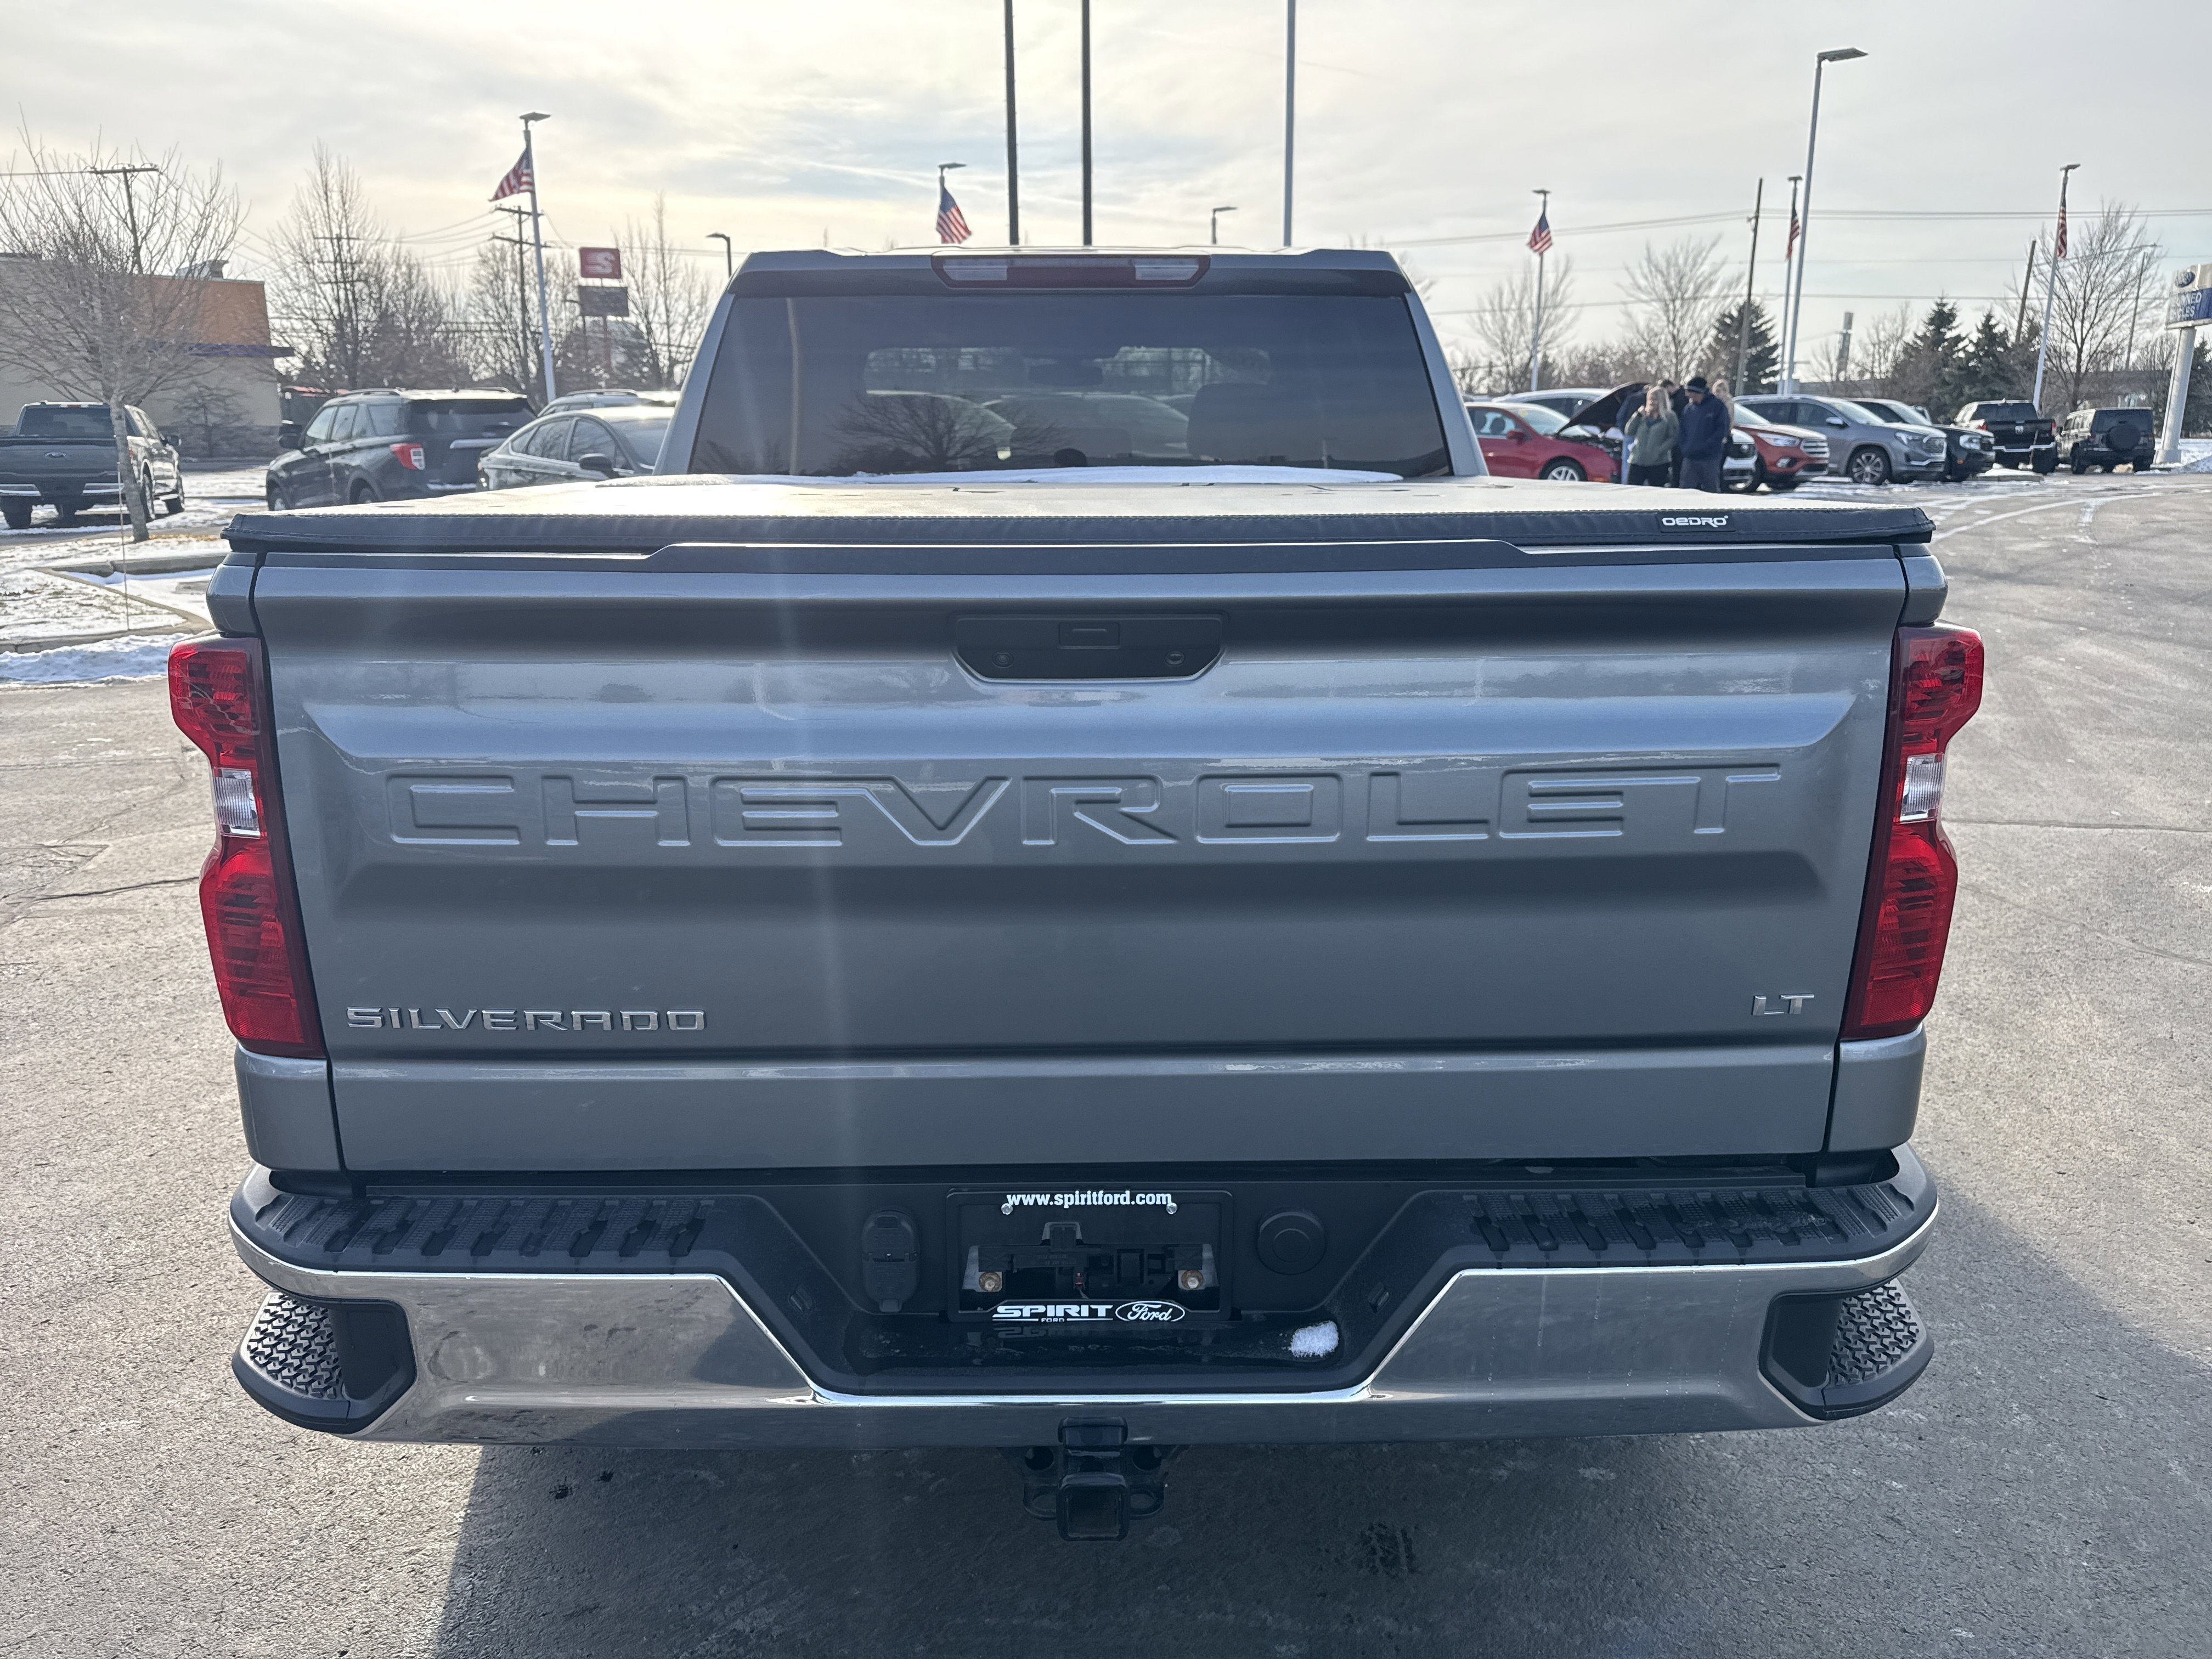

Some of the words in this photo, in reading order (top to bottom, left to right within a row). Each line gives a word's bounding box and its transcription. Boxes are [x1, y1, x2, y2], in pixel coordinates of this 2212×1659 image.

[1662, 517, 1727, 528] OEDRO
[386, 764, 1781, 848] CHEVROLET
[1751, 993, 1815, 1015] LT
[347, 1007, 708, 1031] SILVERADO
[1007, 1190, 1172, 1209] www.spiritford.com
[992, 1305, 1113, 1317] SPIRIT
[1127, 1303, 1172, 1322] Ford
